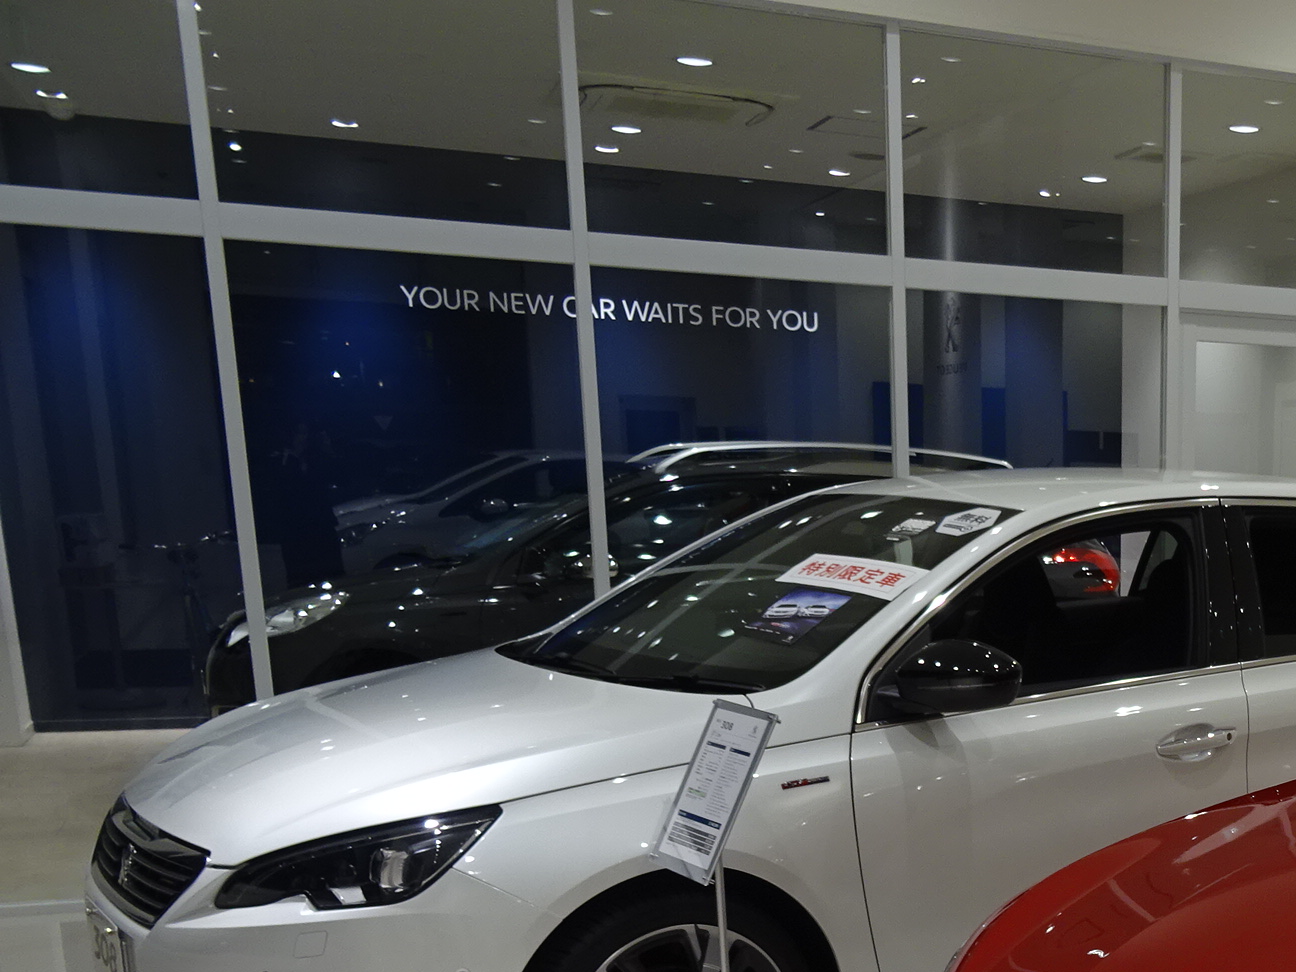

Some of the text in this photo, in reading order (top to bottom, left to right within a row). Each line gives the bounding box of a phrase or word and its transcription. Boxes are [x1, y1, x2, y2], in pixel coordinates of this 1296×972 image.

[400, 285, 480, 312] YOUR
[489, 291, 554, 317] NEW
[623, 299, 703, 326] WAITS
[712, 305, 760, 330] FOR
[767, 309, 819, 333] YOU
[798, 560, 907, 588] 特別限定車
